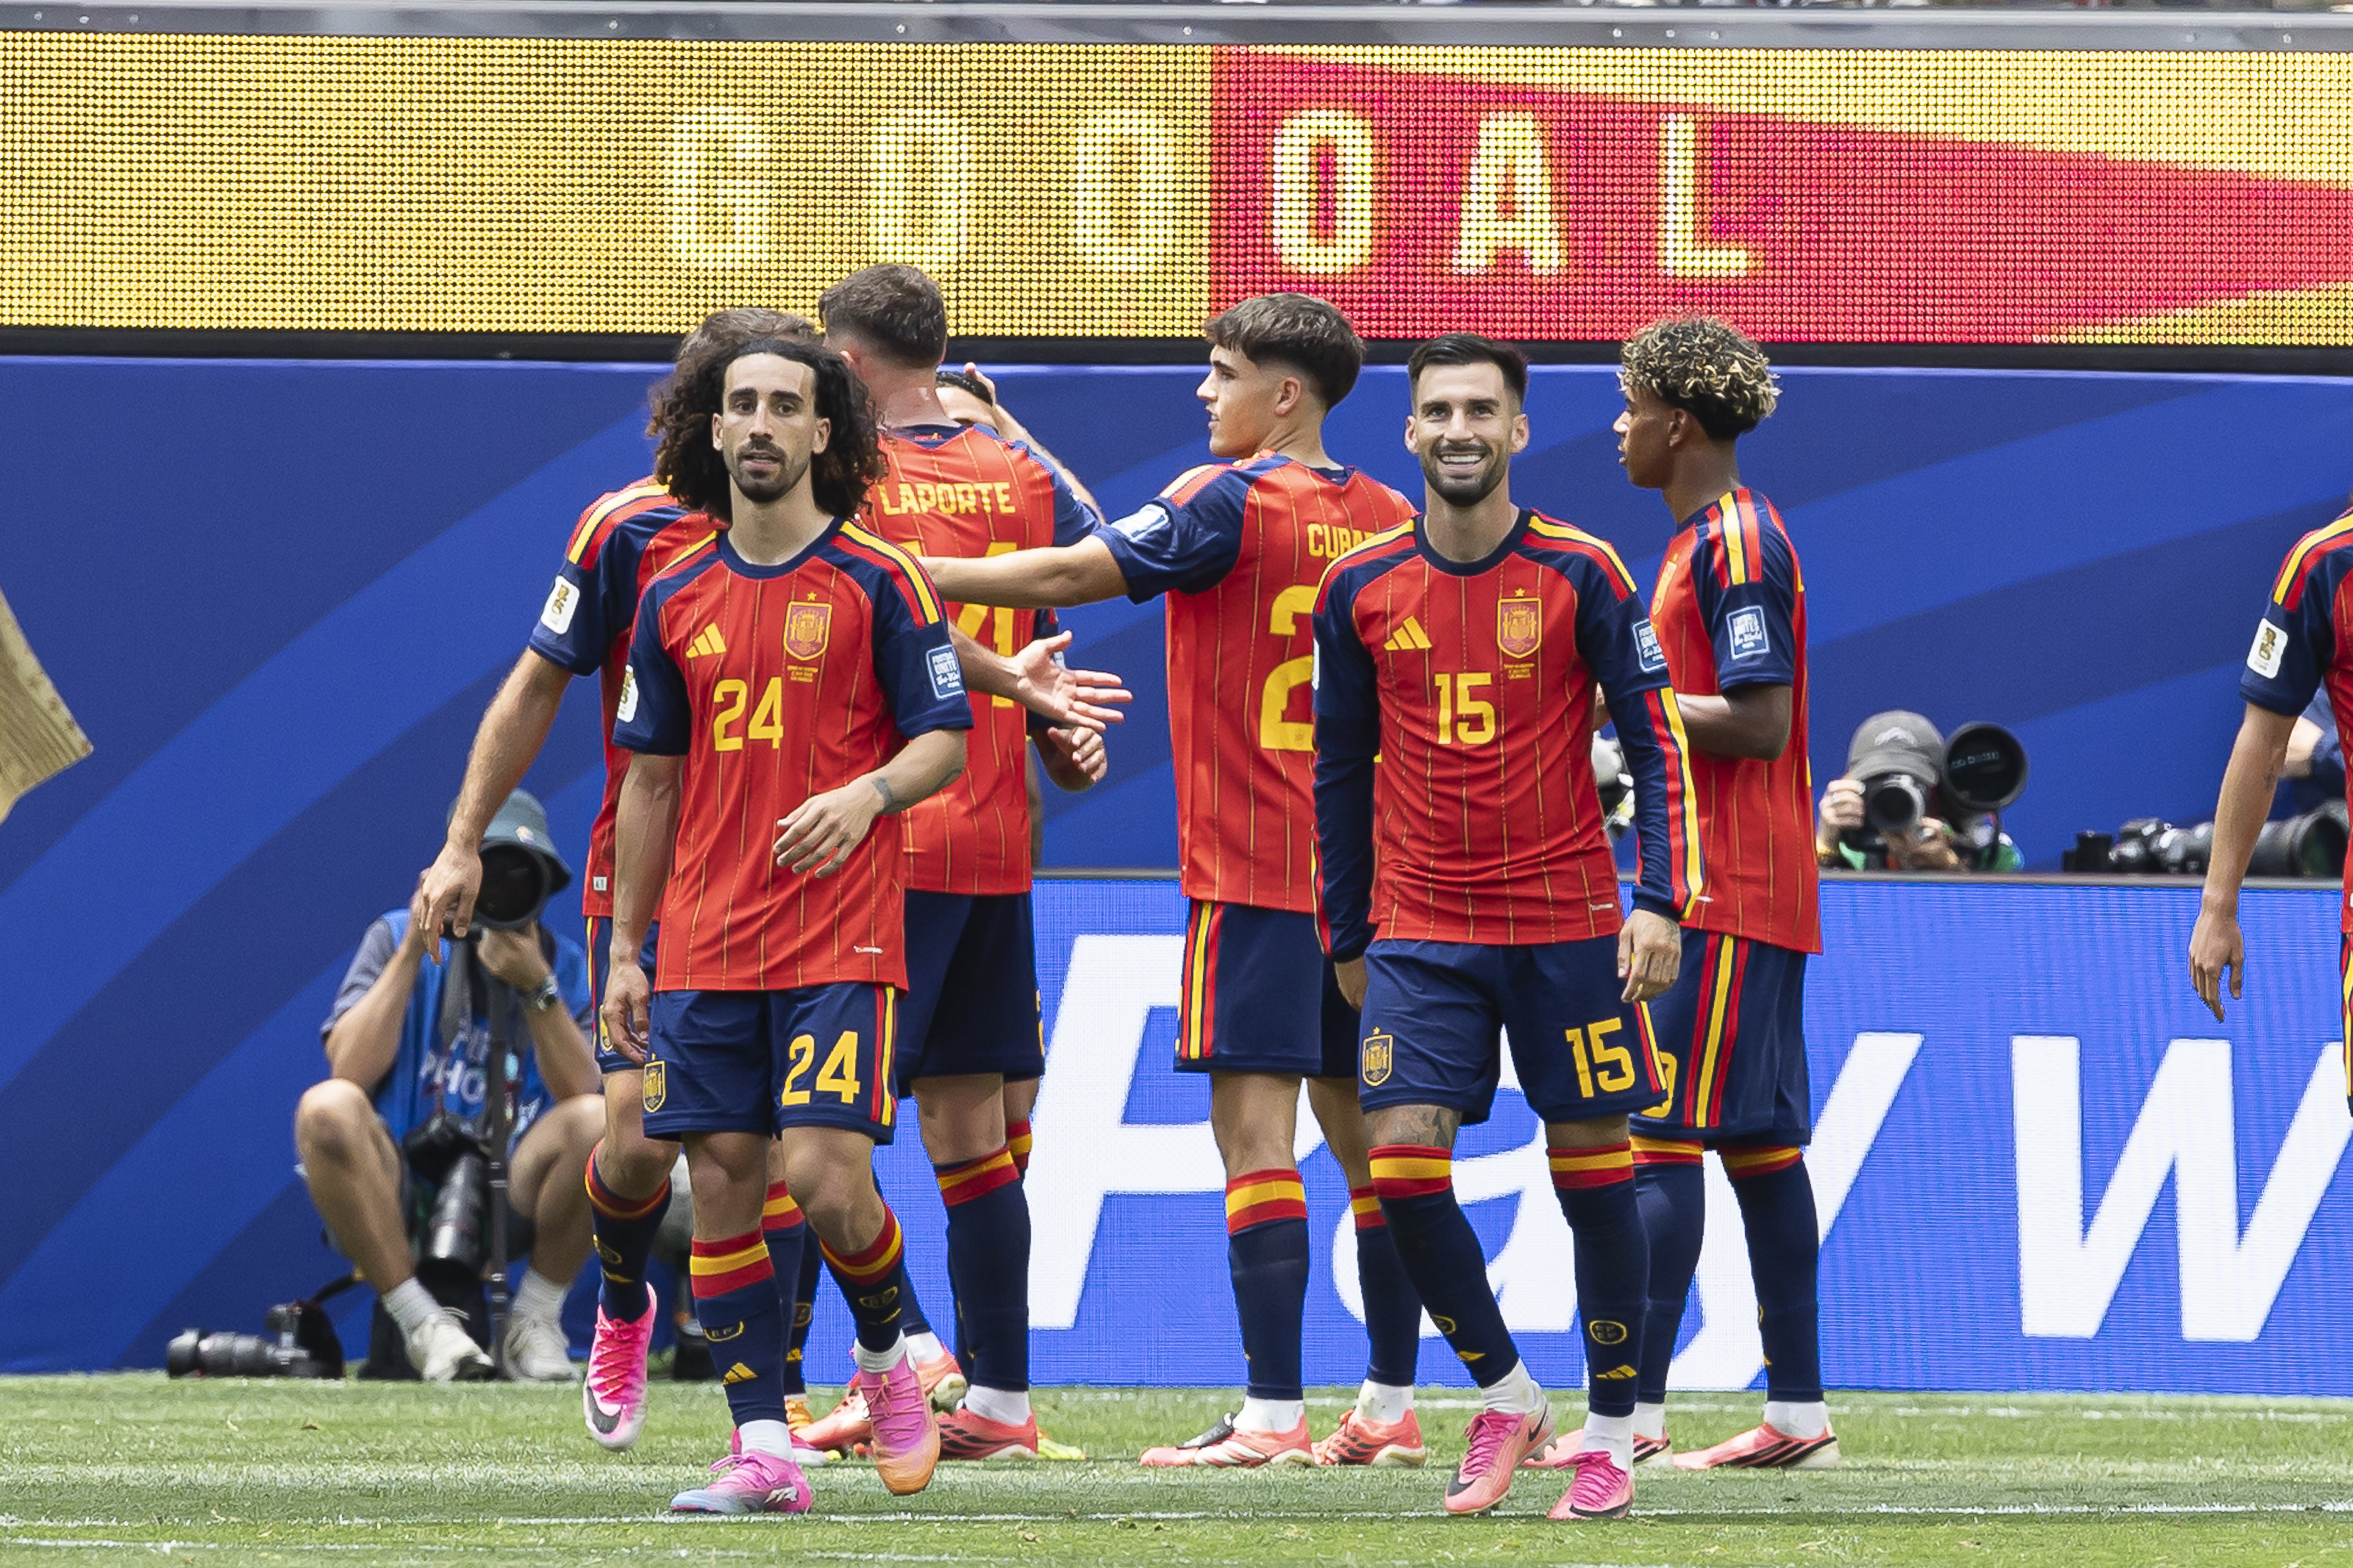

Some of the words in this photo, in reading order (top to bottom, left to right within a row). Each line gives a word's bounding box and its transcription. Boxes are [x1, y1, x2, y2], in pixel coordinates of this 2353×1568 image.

[877, 481, 1016, 516] LAPORTE
[713, 677, 784, 751] 24
[1435, 672, 1496, 745] 15
[782, 1031, 860, 1106] 24
[1565, 1017, 1635, 1098] 15
